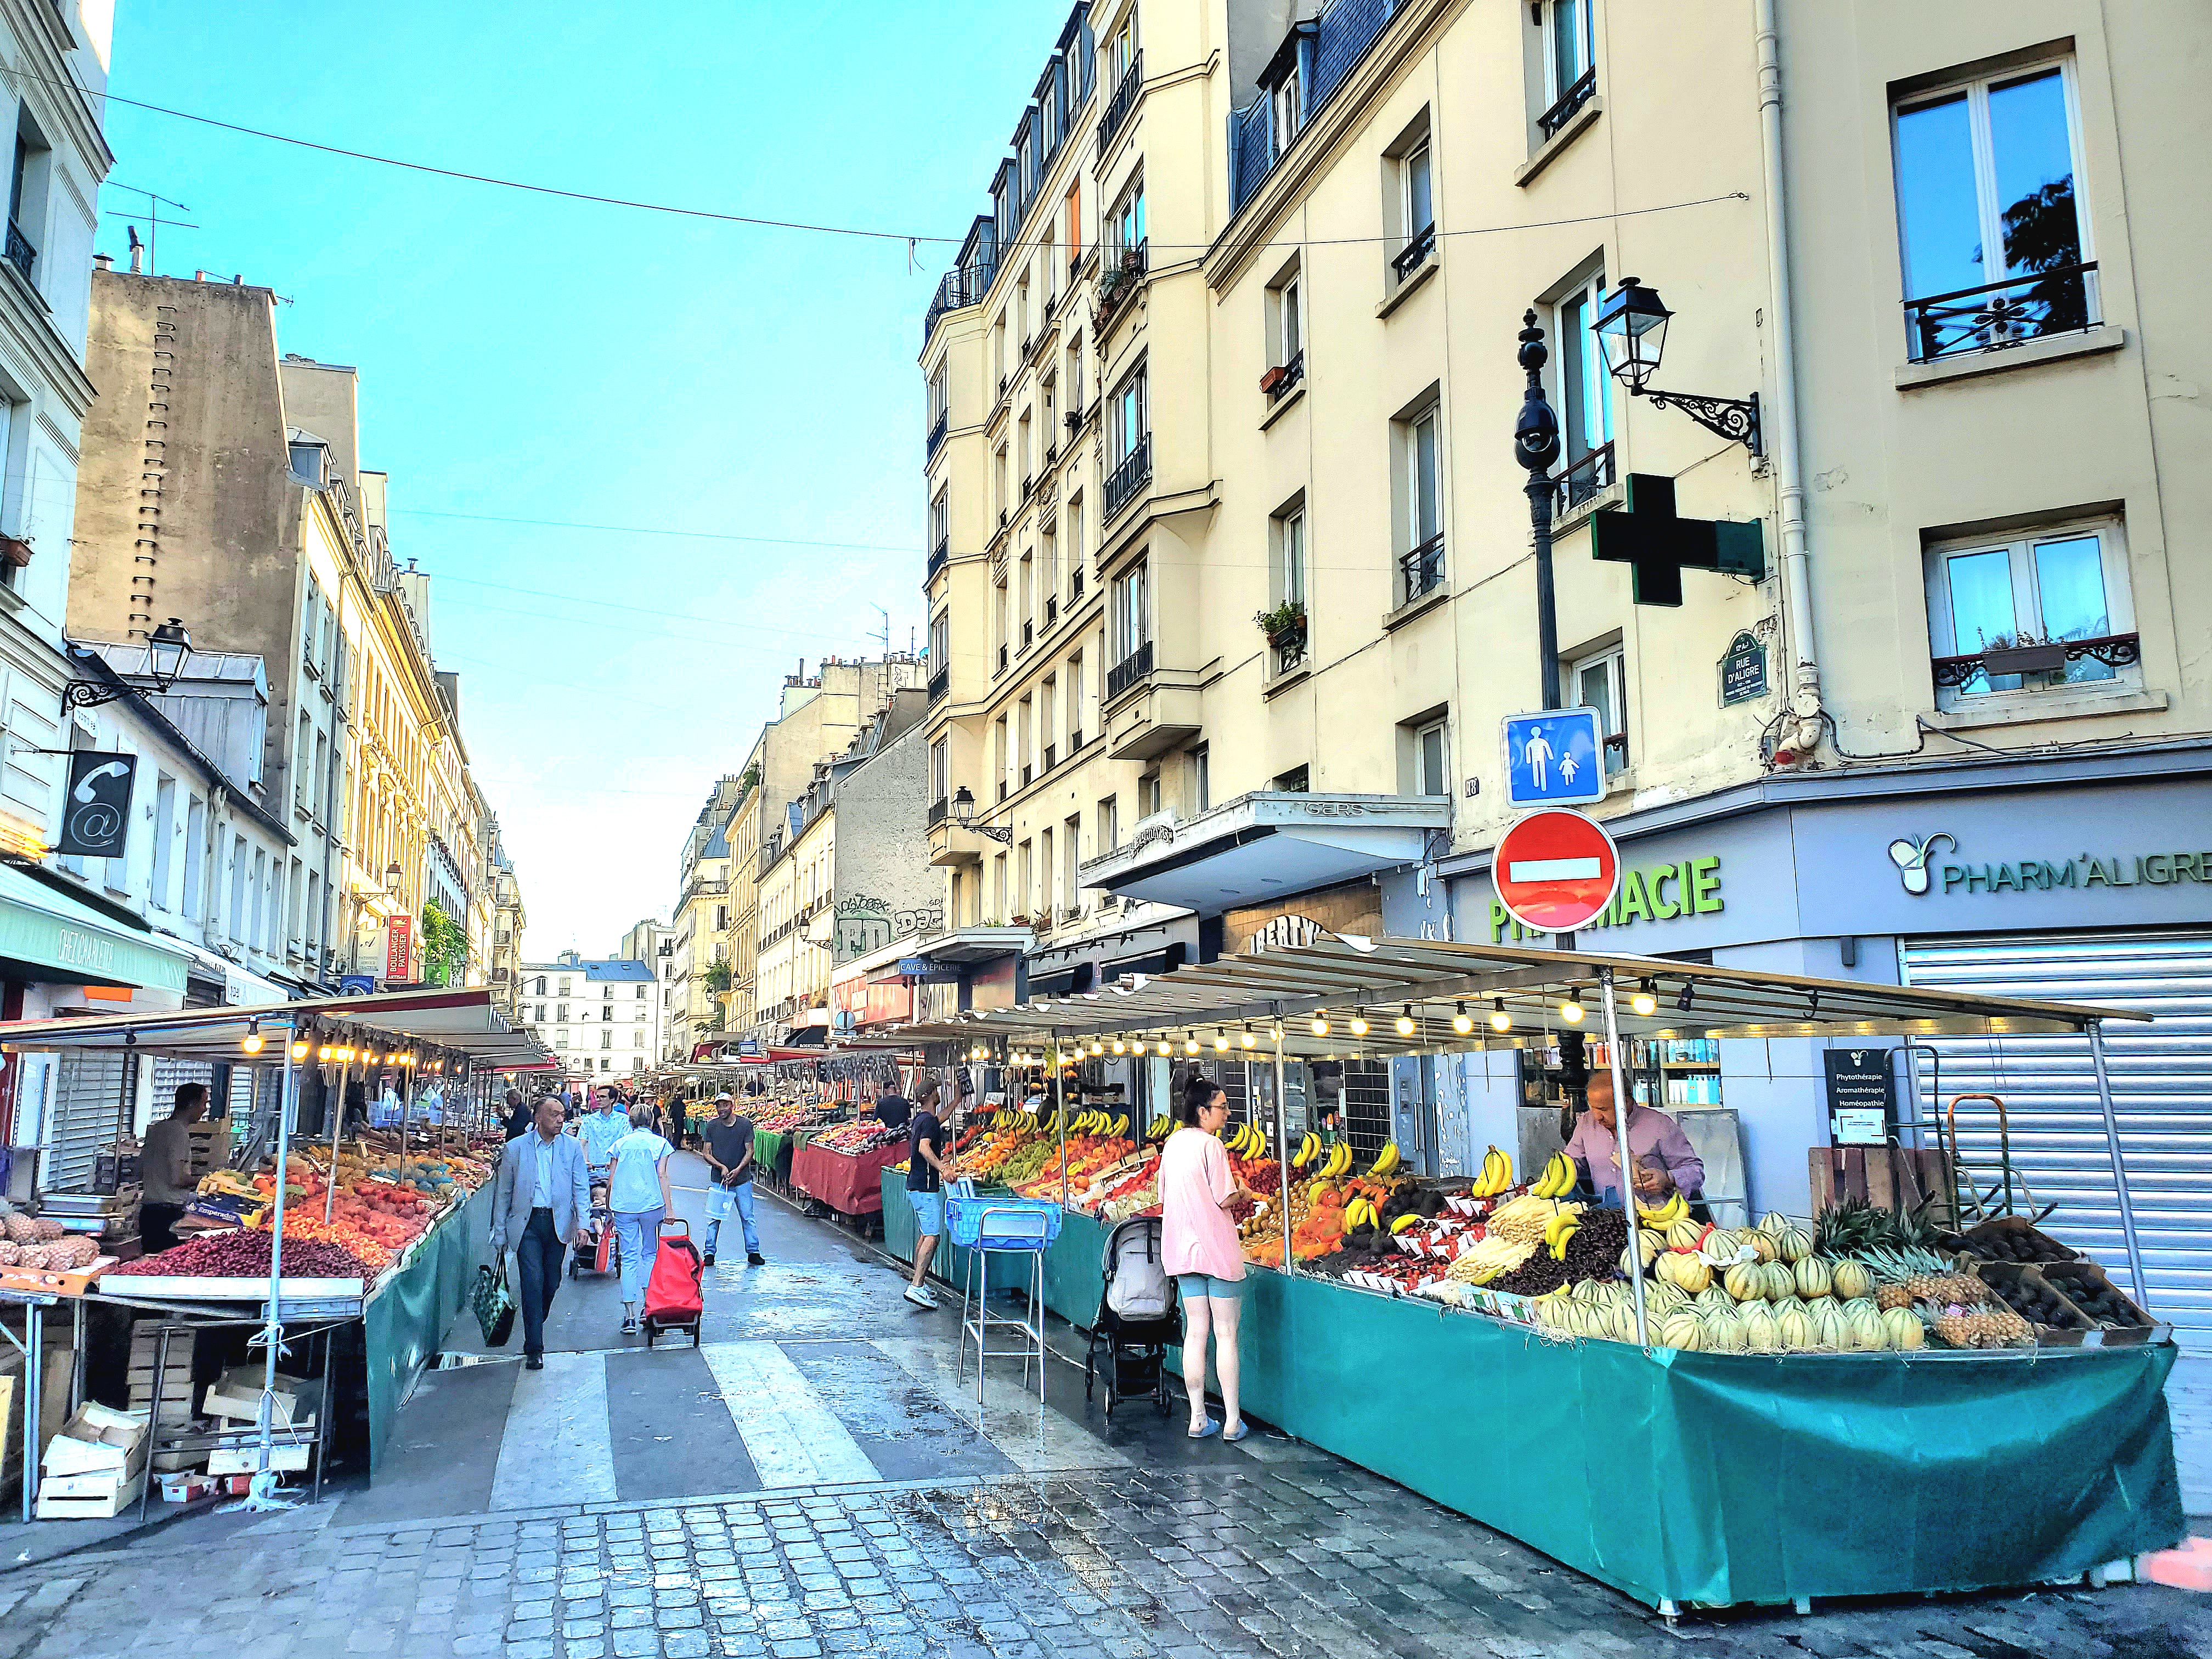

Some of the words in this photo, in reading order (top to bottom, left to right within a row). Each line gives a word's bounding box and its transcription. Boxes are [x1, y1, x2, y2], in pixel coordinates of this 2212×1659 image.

[1728, 664, 1760, 684] D'ALIGRE
[1736, 656, 1751, 670] RUE
[1943, 851, 2212, 894] PHARM'ALIGRE
[58, 928, 79, 963] CHEZ
[390, 928, 399, 972] BOULANGER
[398, 933, 407, 967] PATISSIER
